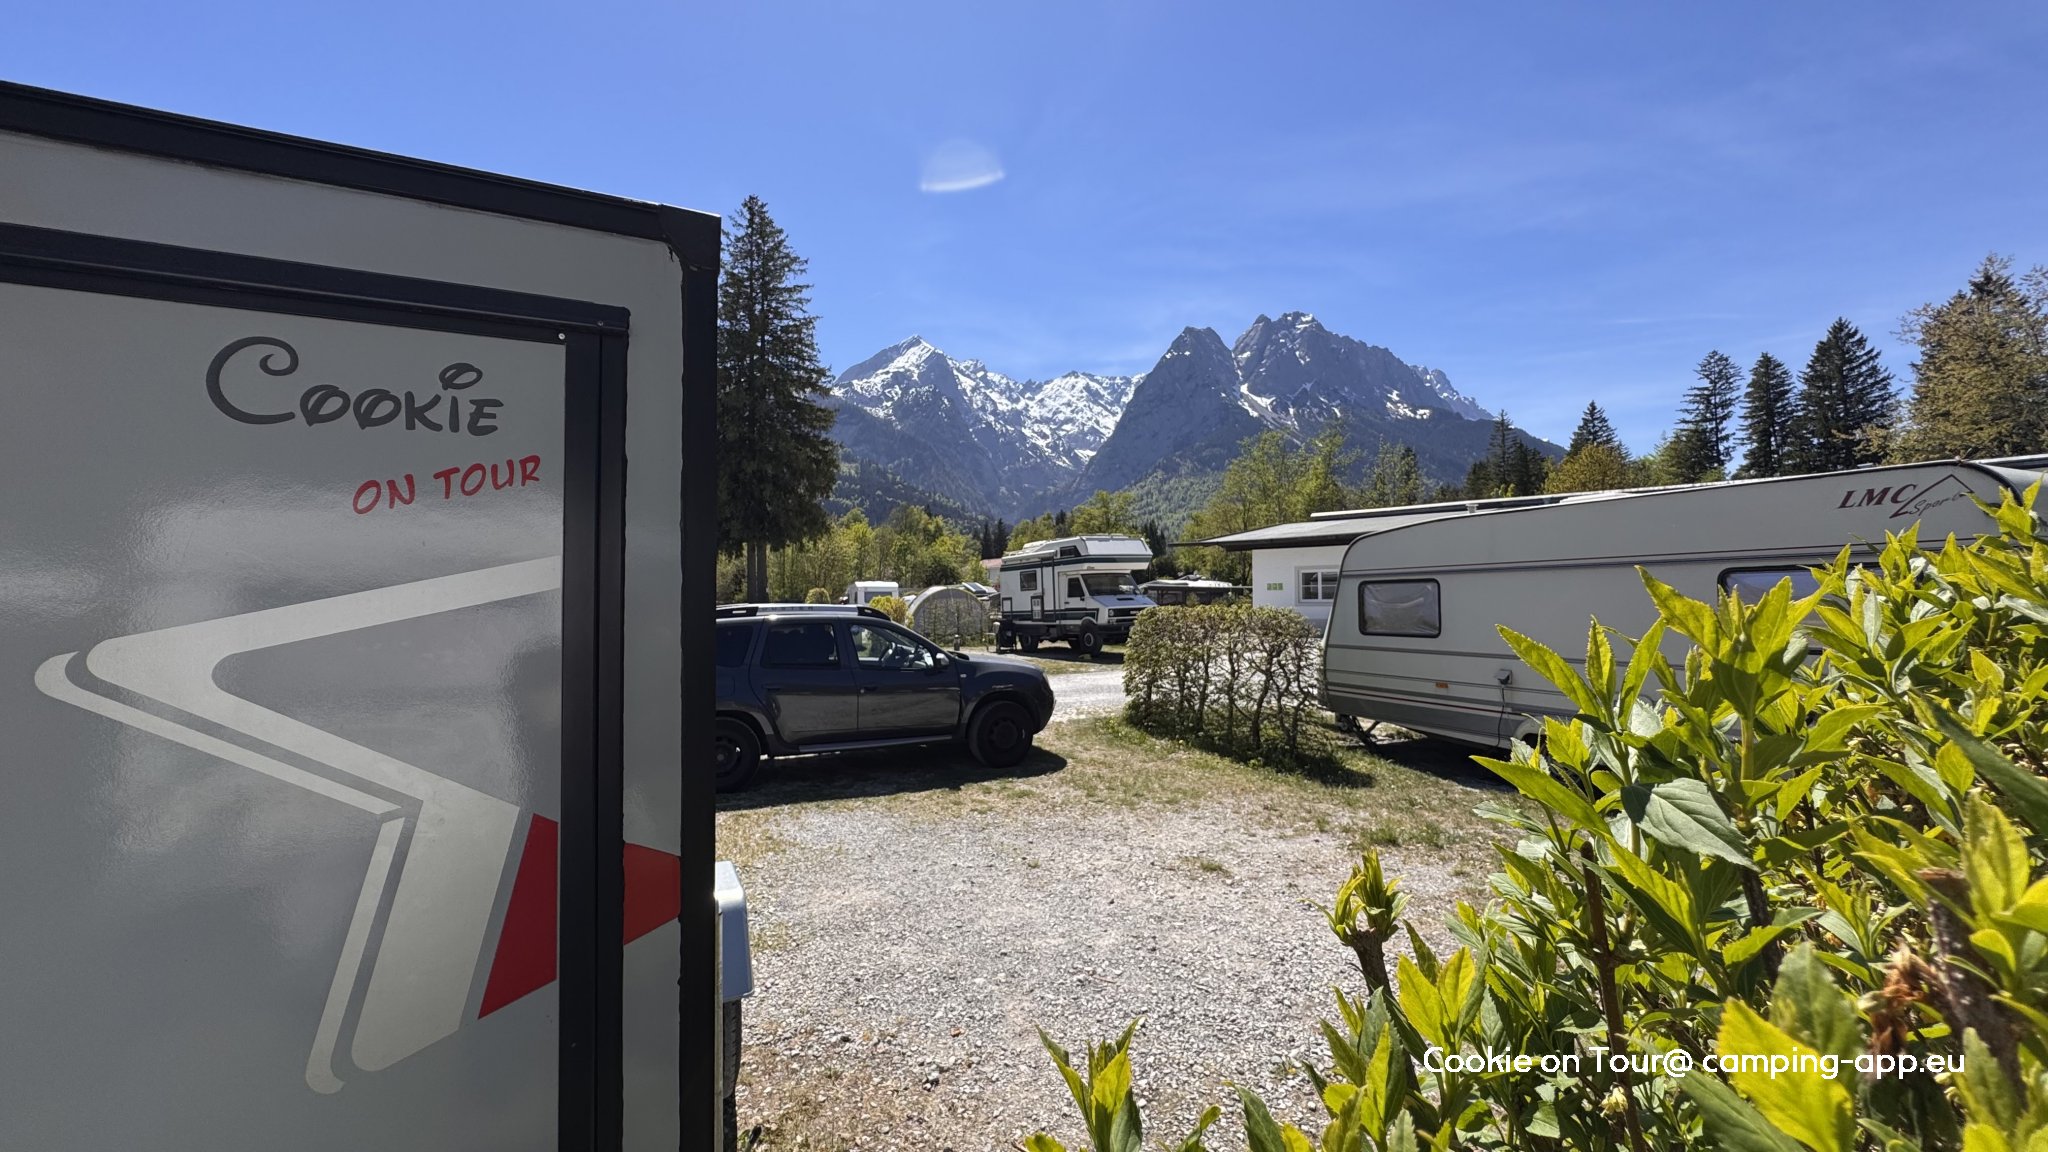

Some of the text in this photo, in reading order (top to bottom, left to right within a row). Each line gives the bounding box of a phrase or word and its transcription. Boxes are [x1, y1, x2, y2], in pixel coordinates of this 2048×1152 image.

[353, 455, 541, 515] ON TOUR
[1837, 484, 1918, 509] LMC
